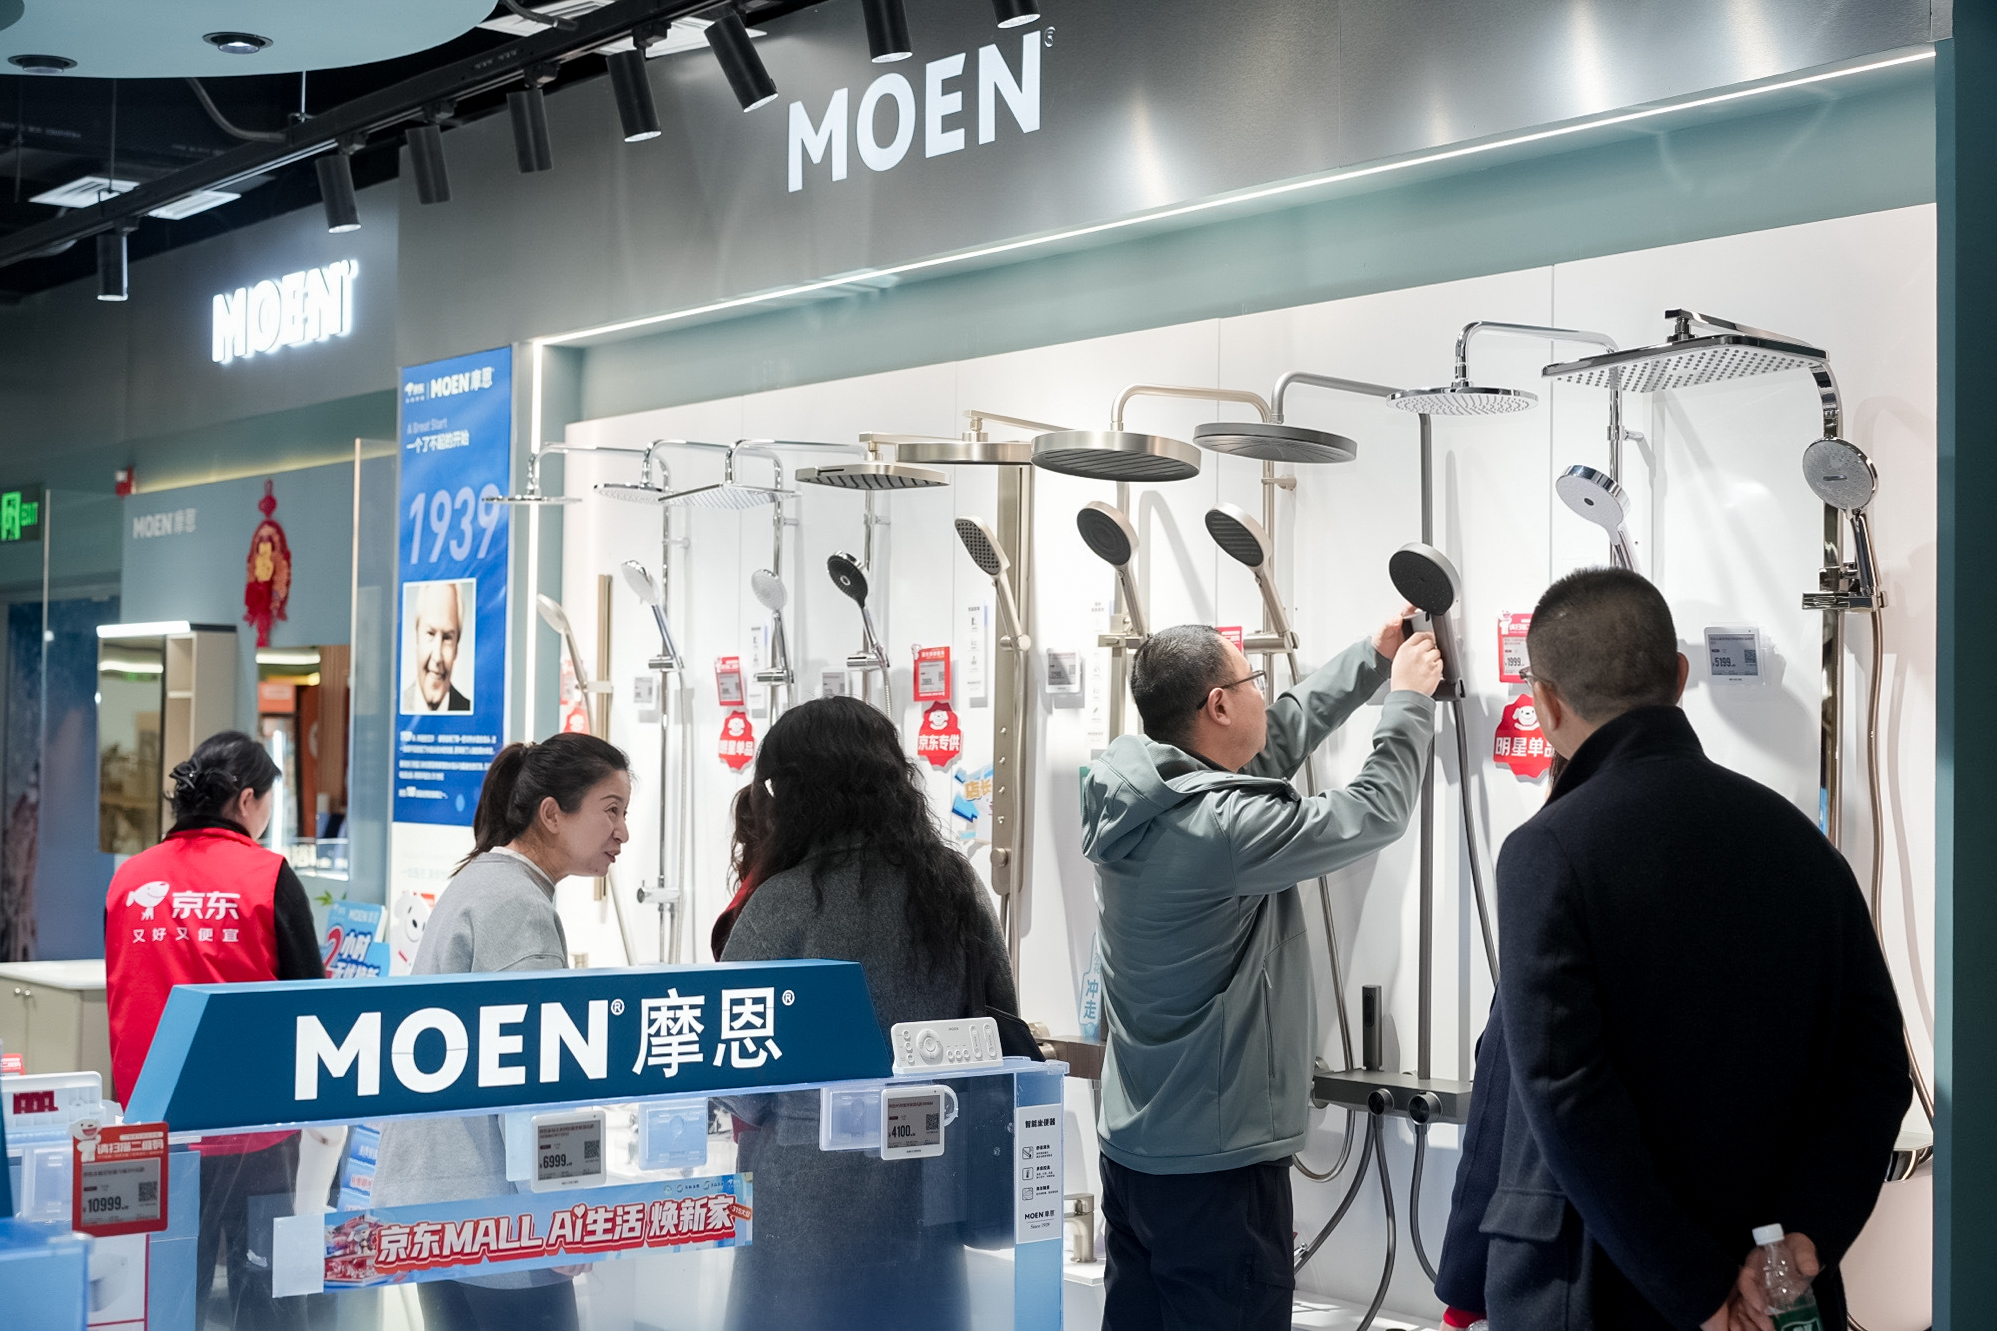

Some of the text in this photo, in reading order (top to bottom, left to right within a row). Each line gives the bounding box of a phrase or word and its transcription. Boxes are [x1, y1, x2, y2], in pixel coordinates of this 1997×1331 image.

[430, 371, 470, 398] MOEN
[132, 512, 174, 539] MOEN
[409, 483, 500, 565] 1939
[918, 733, 960, 751] 京东专供
[172, 890, 240, 920] 京东
[1083, 979, 1099, 1020] 冲走
[649, 1194, 734, 1238] 焕新家
[1024, 1211, 1044, 1220] MOEN
